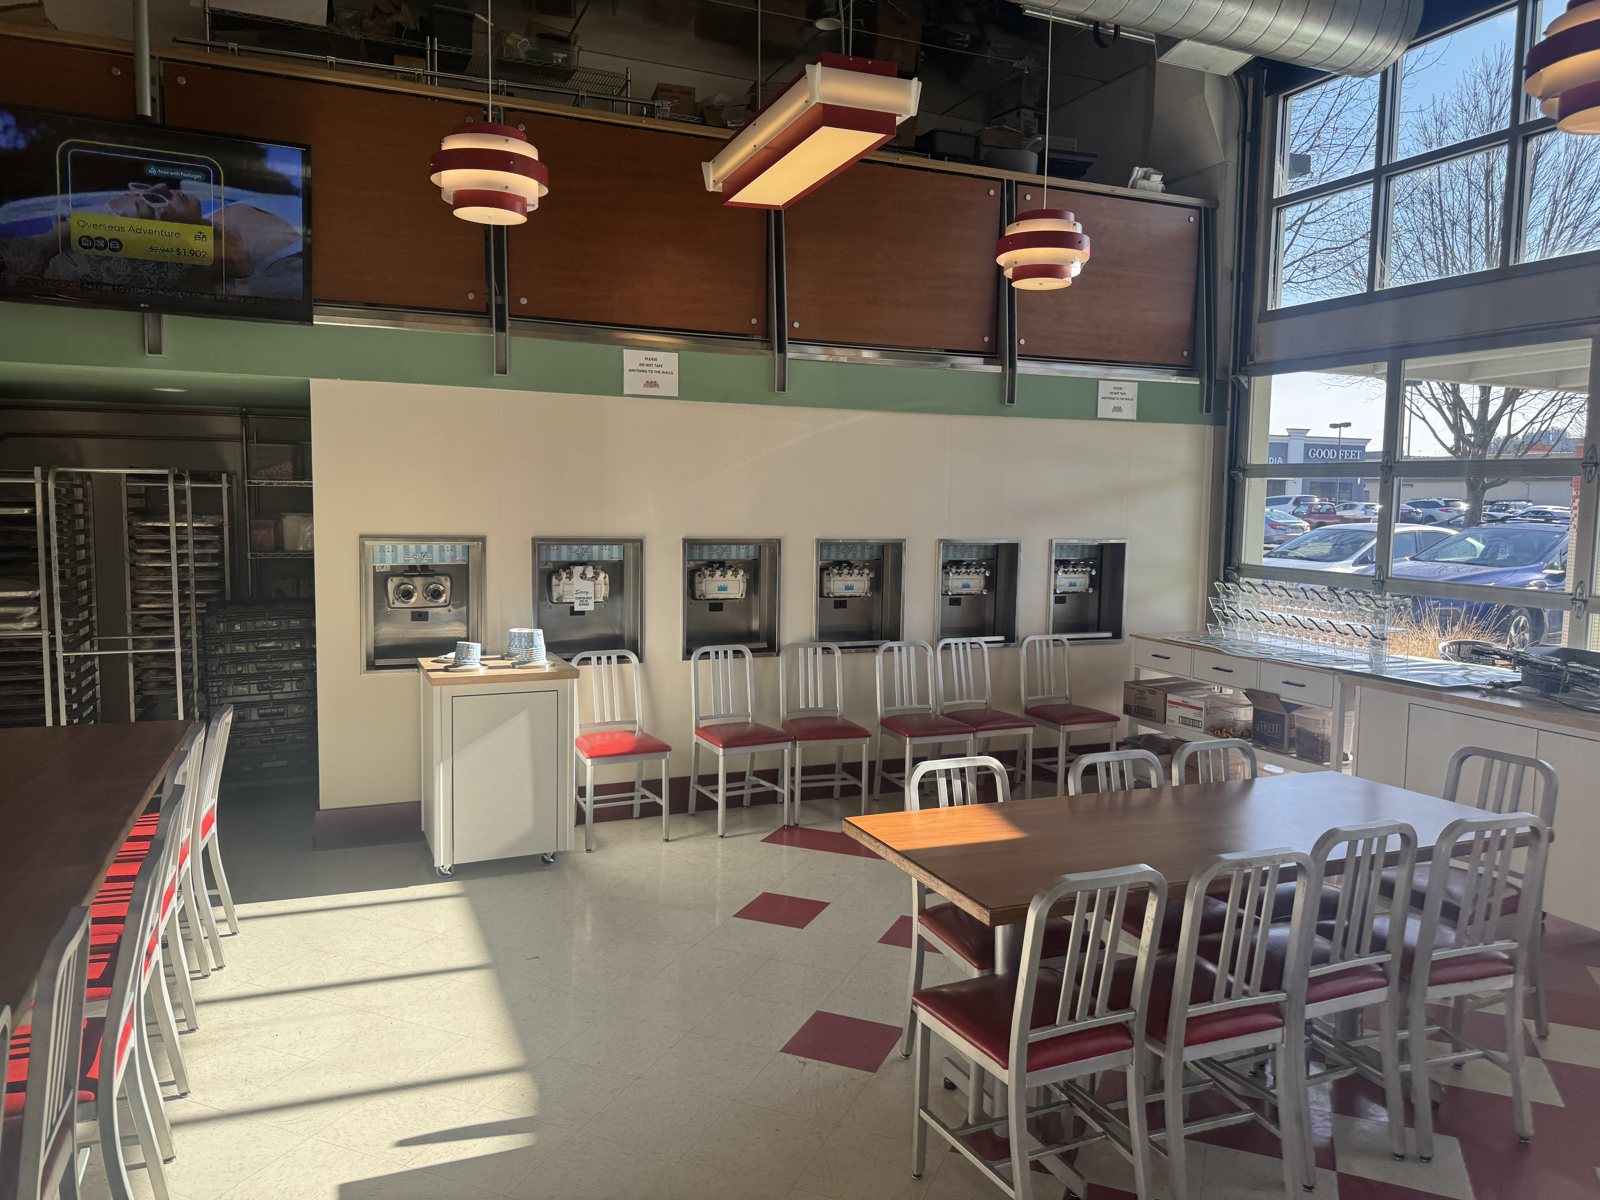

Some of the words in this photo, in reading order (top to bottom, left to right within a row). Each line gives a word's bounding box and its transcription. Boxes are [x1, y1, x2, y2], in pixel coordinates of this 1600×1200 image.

[77, 219, 126, 233] Overseas
[128, 224, 181, 239] Adventure
[175, 247, 208, 259] $1,902
[1308, 448, 1337, 460] GOOD
[1338, 448, 1362, 460] FEET
